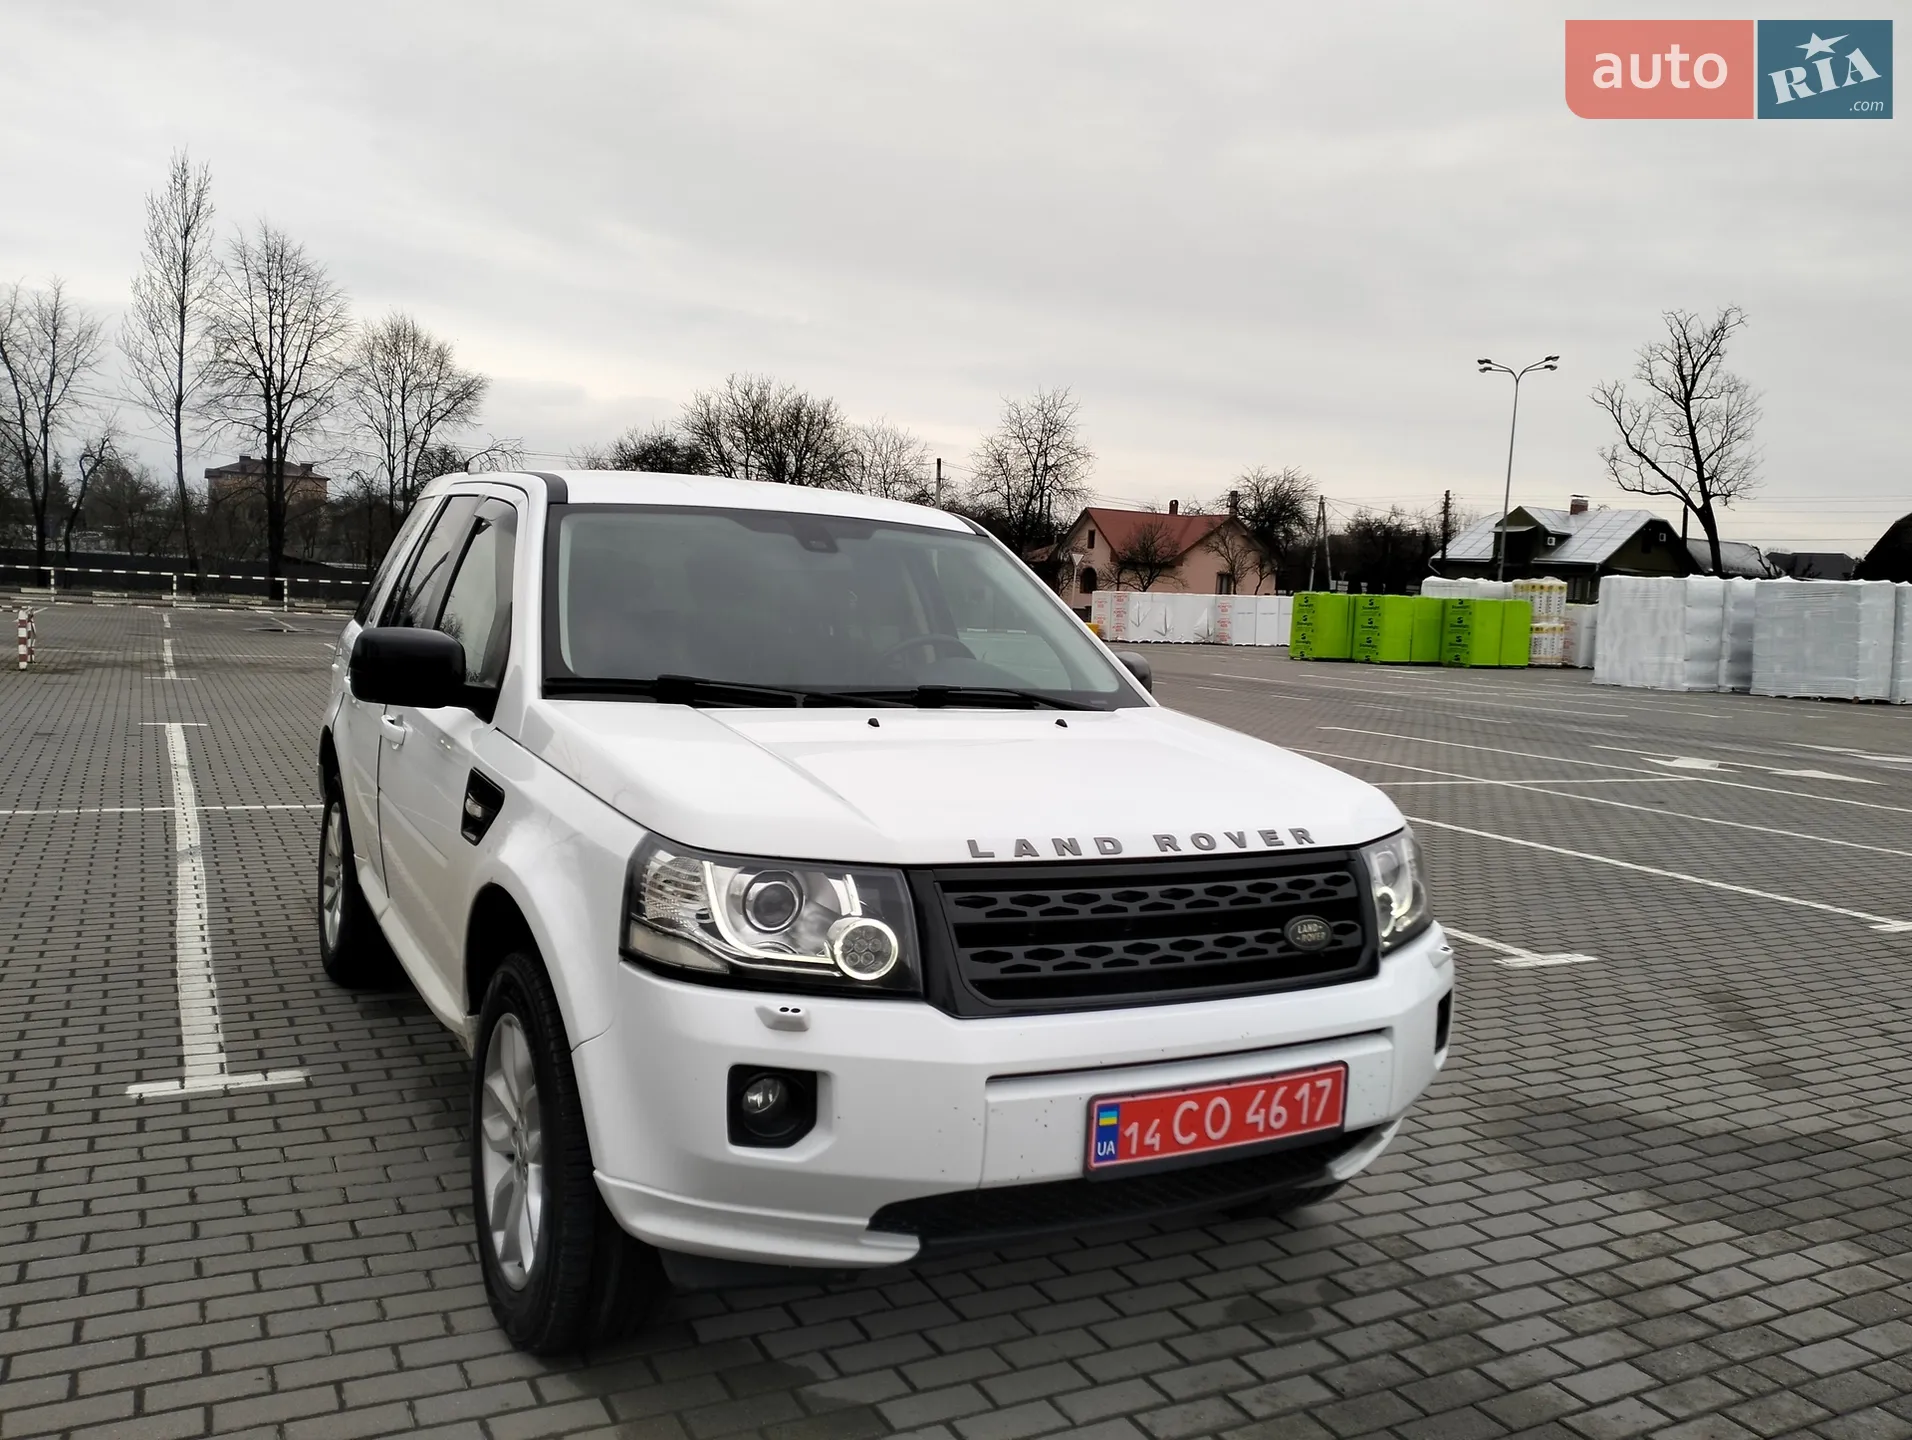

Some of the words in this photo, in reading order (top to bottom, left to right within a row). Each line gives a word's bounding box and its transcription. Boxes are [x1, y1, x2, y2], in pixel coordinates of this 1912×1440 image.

[966, 836, 1123, 858] LAND
[1152, 827, 1316, 852] ROVER
[1123, 1118, 1160, 1155] 14
[1172, 1096, 1232, 1145] CO
[1246, 1078, 1333, 1133] 4617
[1097, 1140, 1116, 1156] UA
